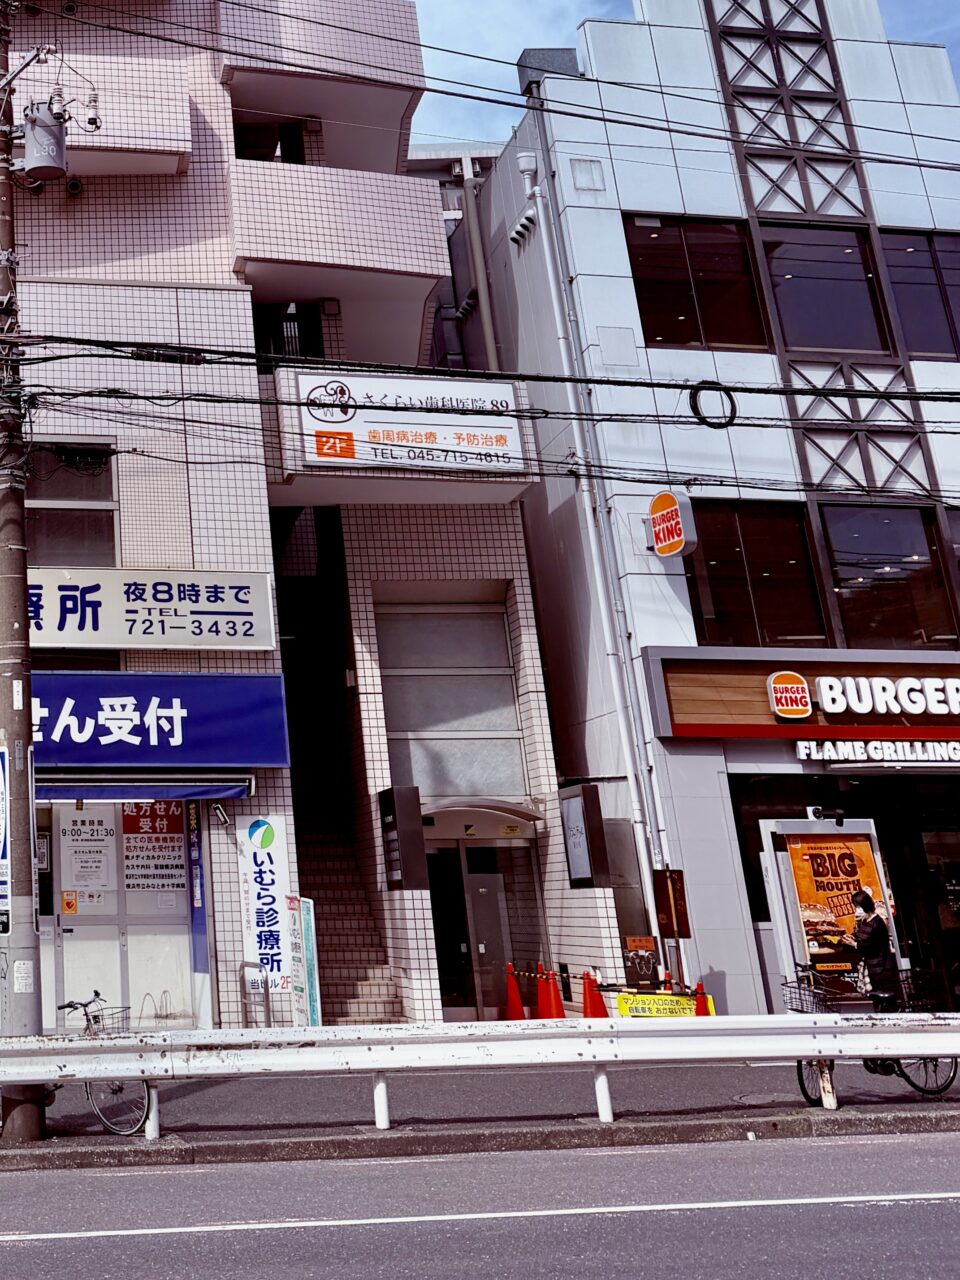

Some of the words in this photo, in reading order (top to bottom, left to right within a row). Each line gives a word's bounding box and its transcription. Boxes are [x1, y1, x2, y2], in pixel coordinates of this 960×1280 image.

[323, 435, 348, 453] 2F
[367, 429, 509, 447] 歯周病治療・予防治療
[371, 447, 403, 460] TEL.
[651, 507, 680, 528] BURGER
[653, 520, 683, 546] KING
[123, 582, 251, 604] 夜8時まで
[142, 608, 187, 617] TEL
[772, 685, 807, 696] BURGER
[774, 695, 809, 708] KING
[797, 740, 867, 761] FLAME
[867, 740, 960, 761] GRILLING
[124, 801, 182, 816] 処方せん
[139, 818, 168, 832] 受付
[809, 852, 859, 878] BIG
[814, 879, 862, 892] MOUTH
[252, 851, 283, 973] いむら診療所
